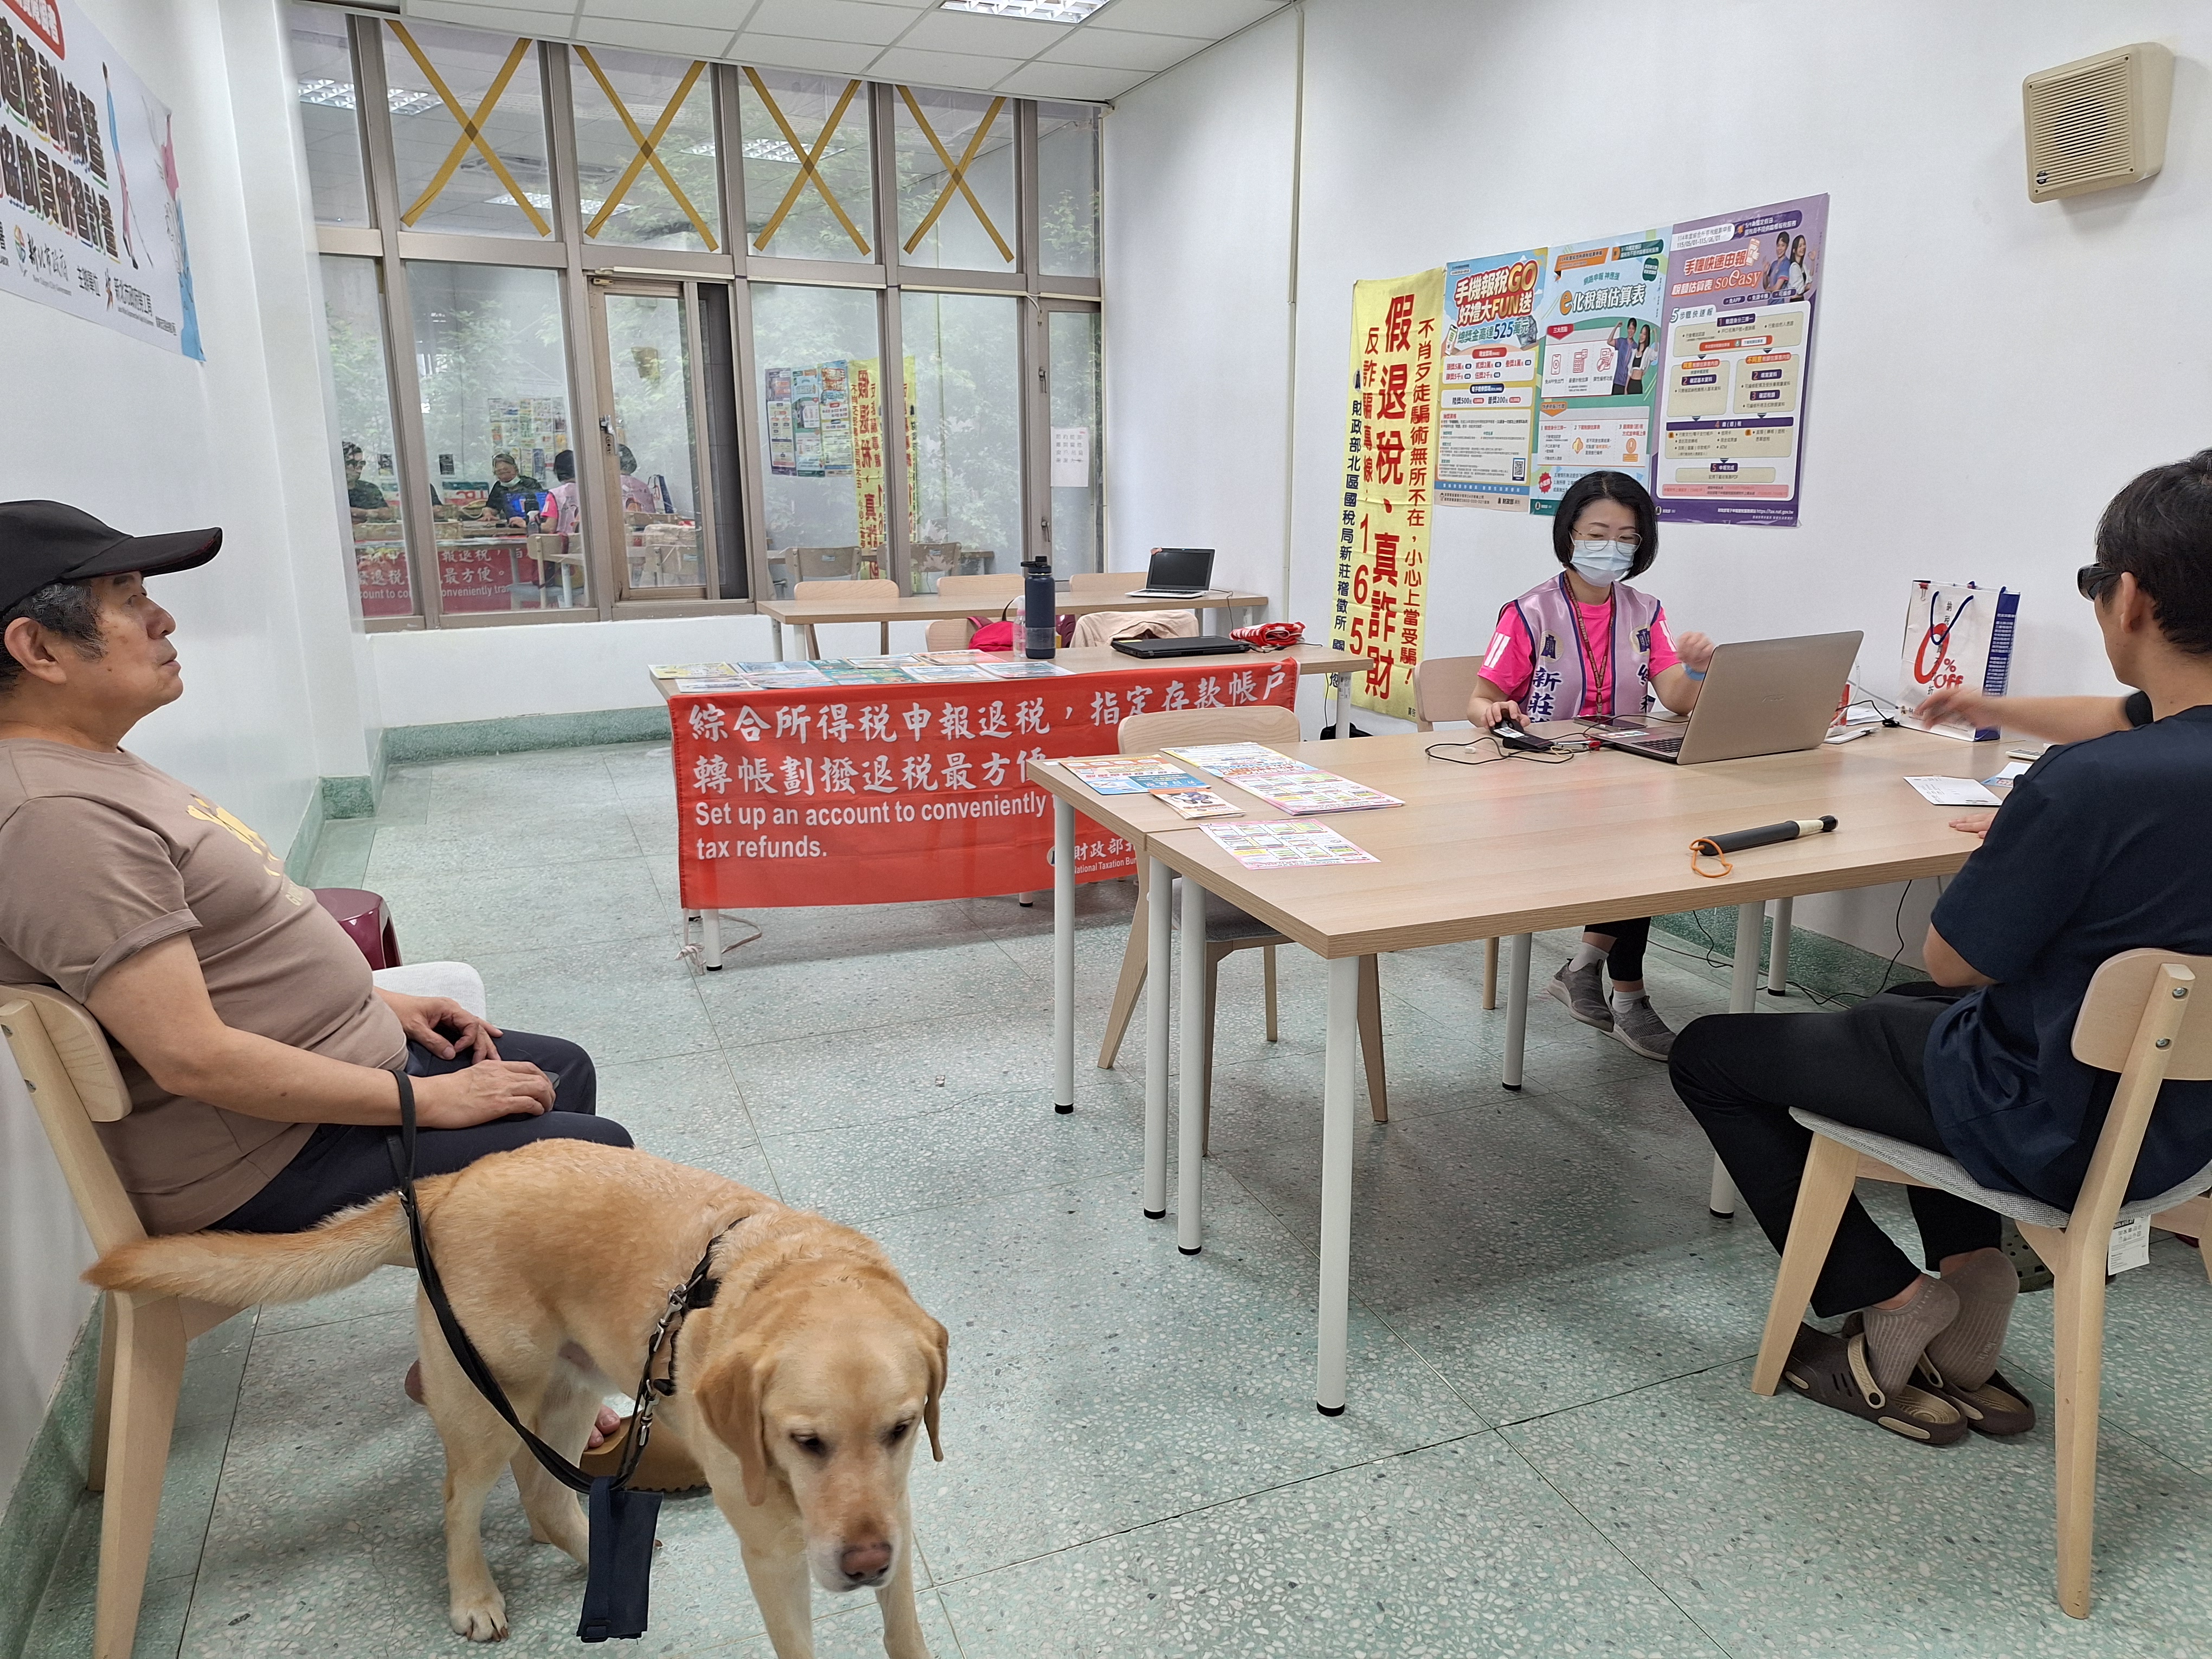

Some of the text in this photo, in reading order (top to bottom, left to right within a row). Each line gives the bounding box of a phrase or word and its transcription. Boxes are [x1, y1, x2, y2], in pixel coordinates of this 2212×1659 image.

[1684, 250, 1747, 275] 手機快速申報
[1455, 262, 1538, 305] 手機報稅GO
[1458, 291, 1533, 325] 好禮大FUN送
[1457, 320, 1529, 344] 總獎金高達525萬元
[1364, 293, 1414, 699] 假退稅、真詐財
[1335, 400, 1361, 631] 財政部北區國稅局新莊稽徵所
[361, 589, 384, 599] ount
[387, 589, 395, 599] to
[442, 585, 493, 596] onveniently
[689, 665, 1286, 744] 綜合所得稅申報退稅，指定存款帳戶
[1528, 666, 1562, 722] 新莊
[696, 802, 732, 826] Set
[738, 806, 767, 830] up
[773, 806, 799, 825] an
[806, 801, 891, 826] account
[895, 801, 915, 822] to
[921, 790, 1047, 821] conveniently
[697, 835, 827, 860] tax refunds.
[1098, 858, 1124, 870] Taxation
[1126, 857, 1137, 865] Bur
